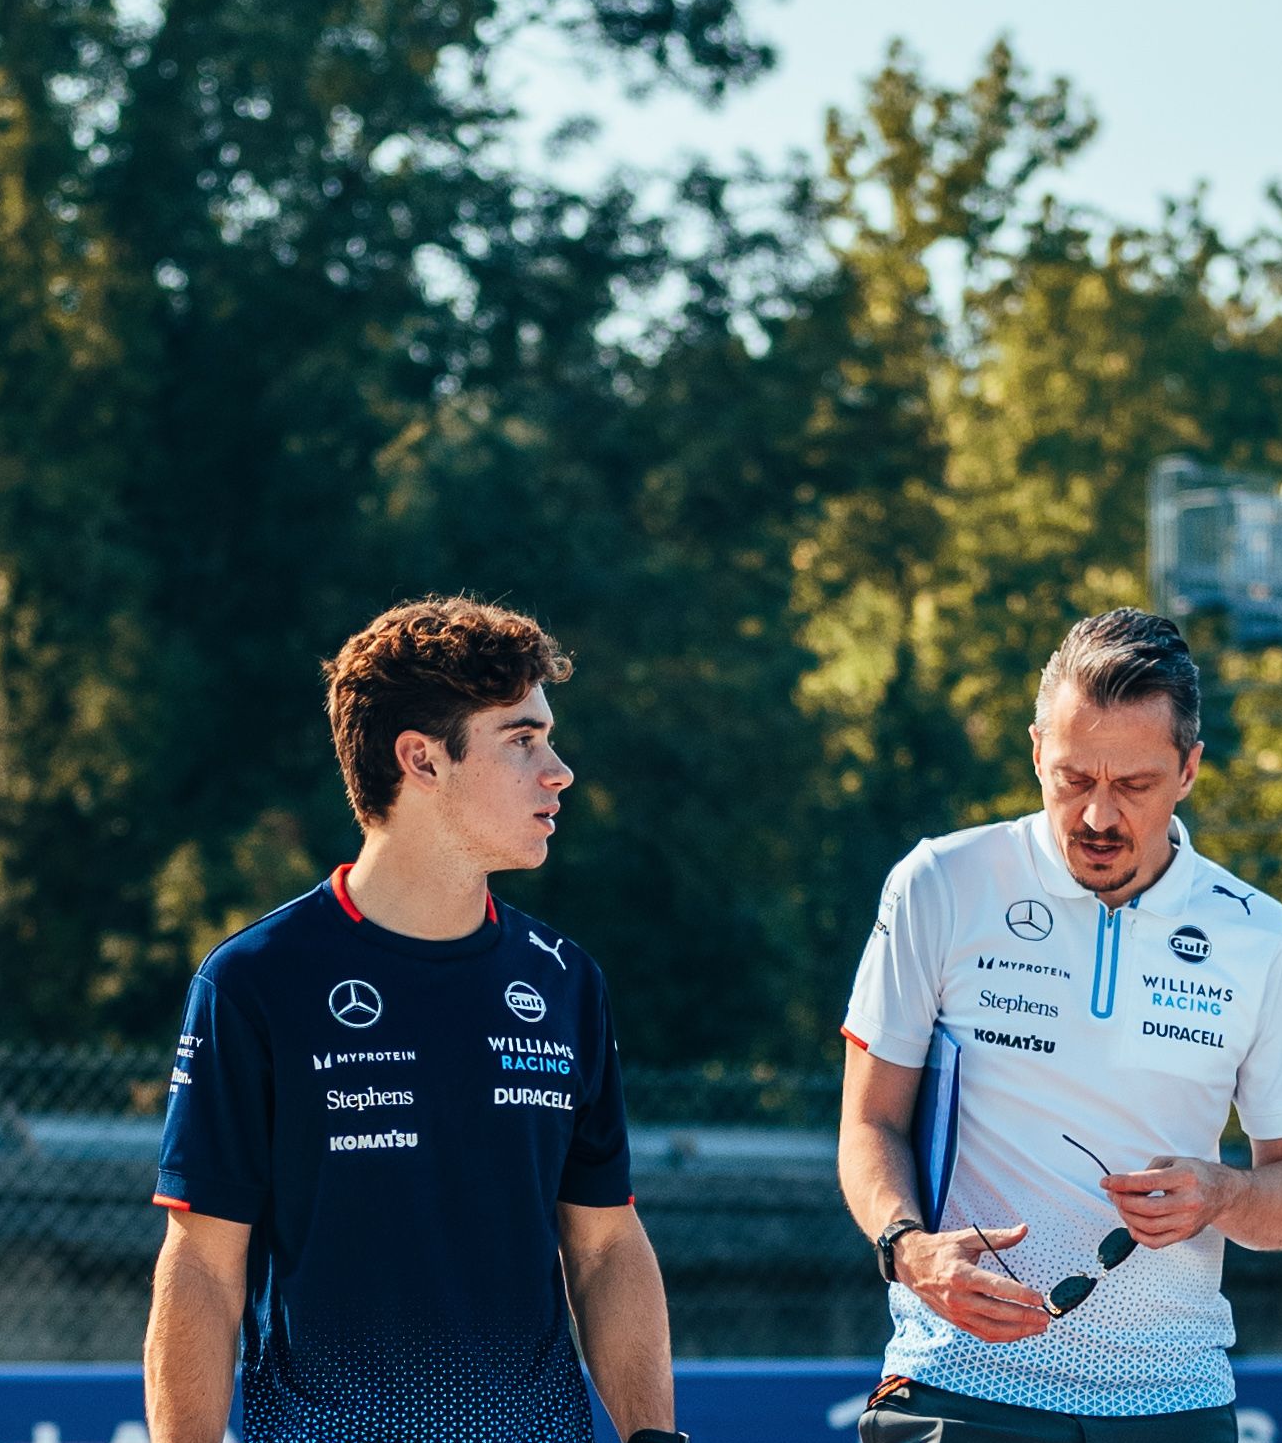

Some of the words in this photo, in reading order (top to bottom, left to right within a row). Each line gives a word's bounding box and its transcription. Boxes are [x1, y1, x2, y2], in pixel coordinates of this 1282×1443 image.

[1169, 937, 1210, 956] Gulf
[998, 959, 1071, 980] MYPROTEIN
[1142, 974, 1234, 1002] WILLIAMS
[508, 993, 544, 1009] Gulf
[978, 989, 1059, 1018] Stephens
[1152, 992, 1222, 1016] RACING
[973, 1028, 1056, 1054] KOMATSU
[1142, 1020, 1225, 1049] DURACELL
[336, 1051, 417, 1065] MYPROTEIN
[487, 1036, 575, 1060] WILLIAMS
[501, 1054, 571, 1075] RACING
[326, 1086, 415, 1111] Stephens
[493, 1087, 574, 1110] DURACELL
[329, 1129, 419, 1152] KOMATSU
